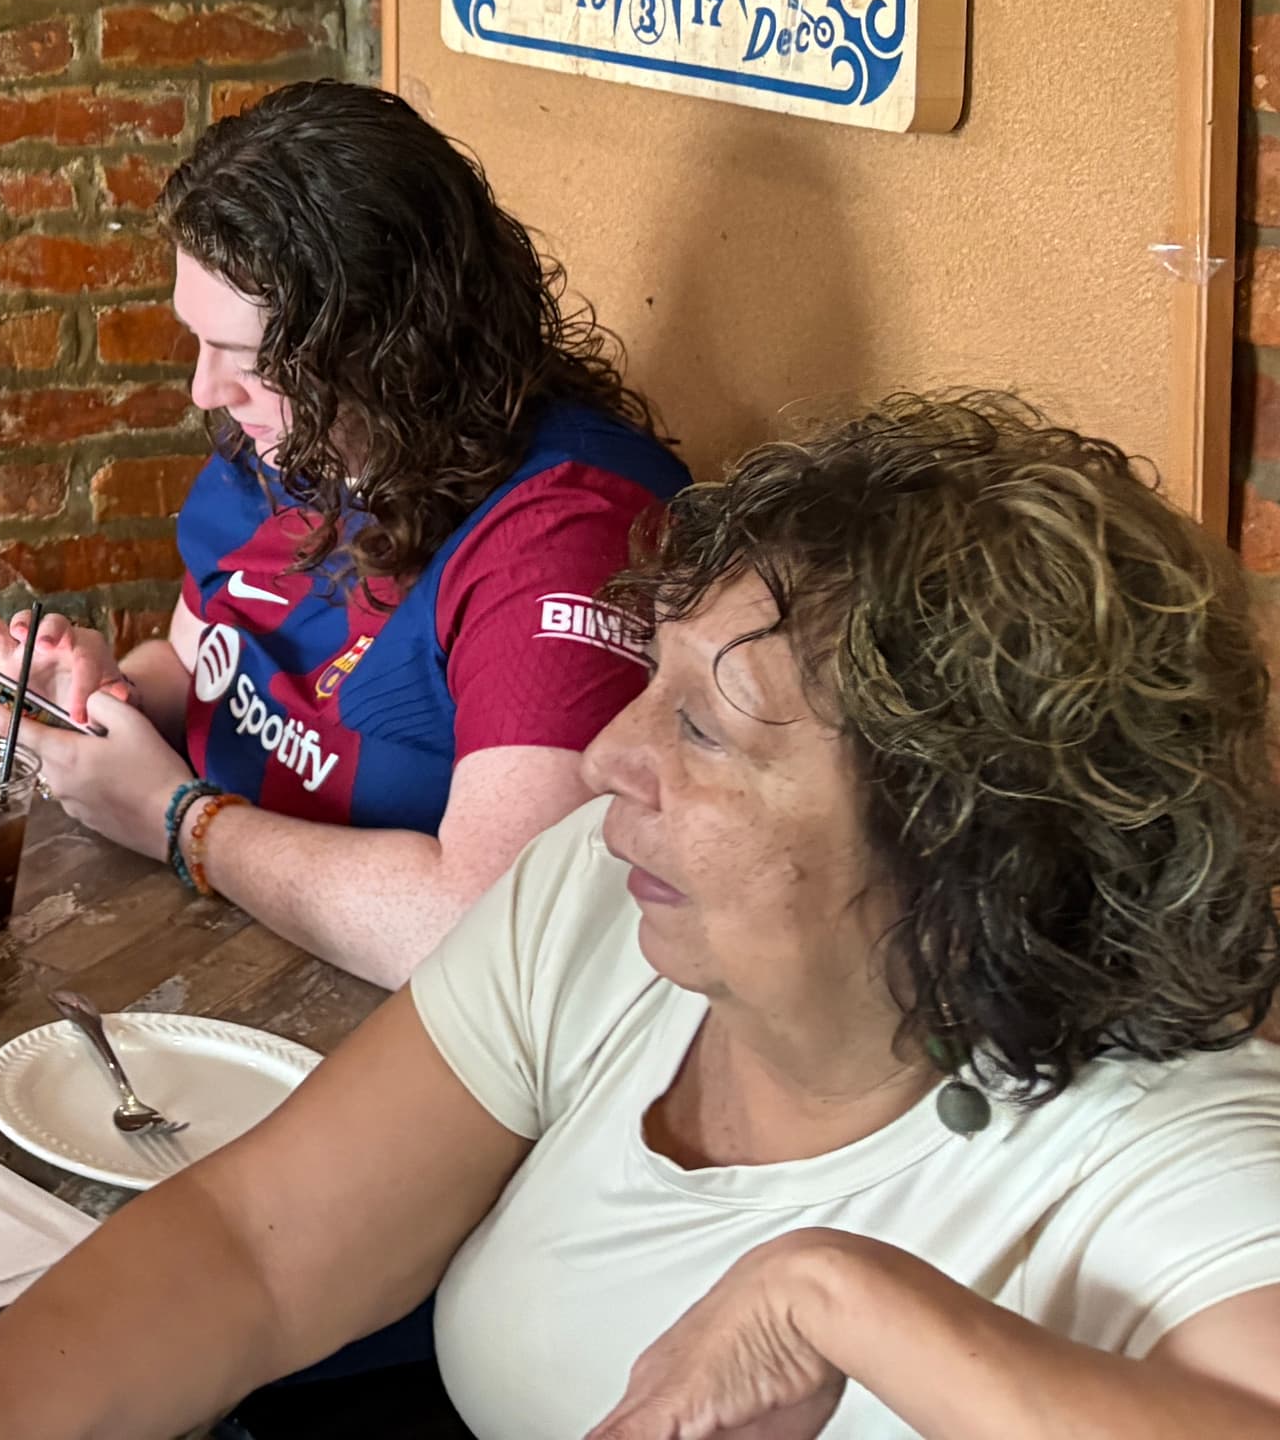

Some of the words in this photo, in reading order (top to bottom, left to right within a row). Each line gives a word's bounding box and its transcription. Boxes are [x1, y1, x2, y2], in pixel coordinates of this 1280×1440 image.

[742, 7, 835, 62] Deco
[541, 600, 644, 653] BIM
[229, 672, 339, 792] Spotify
